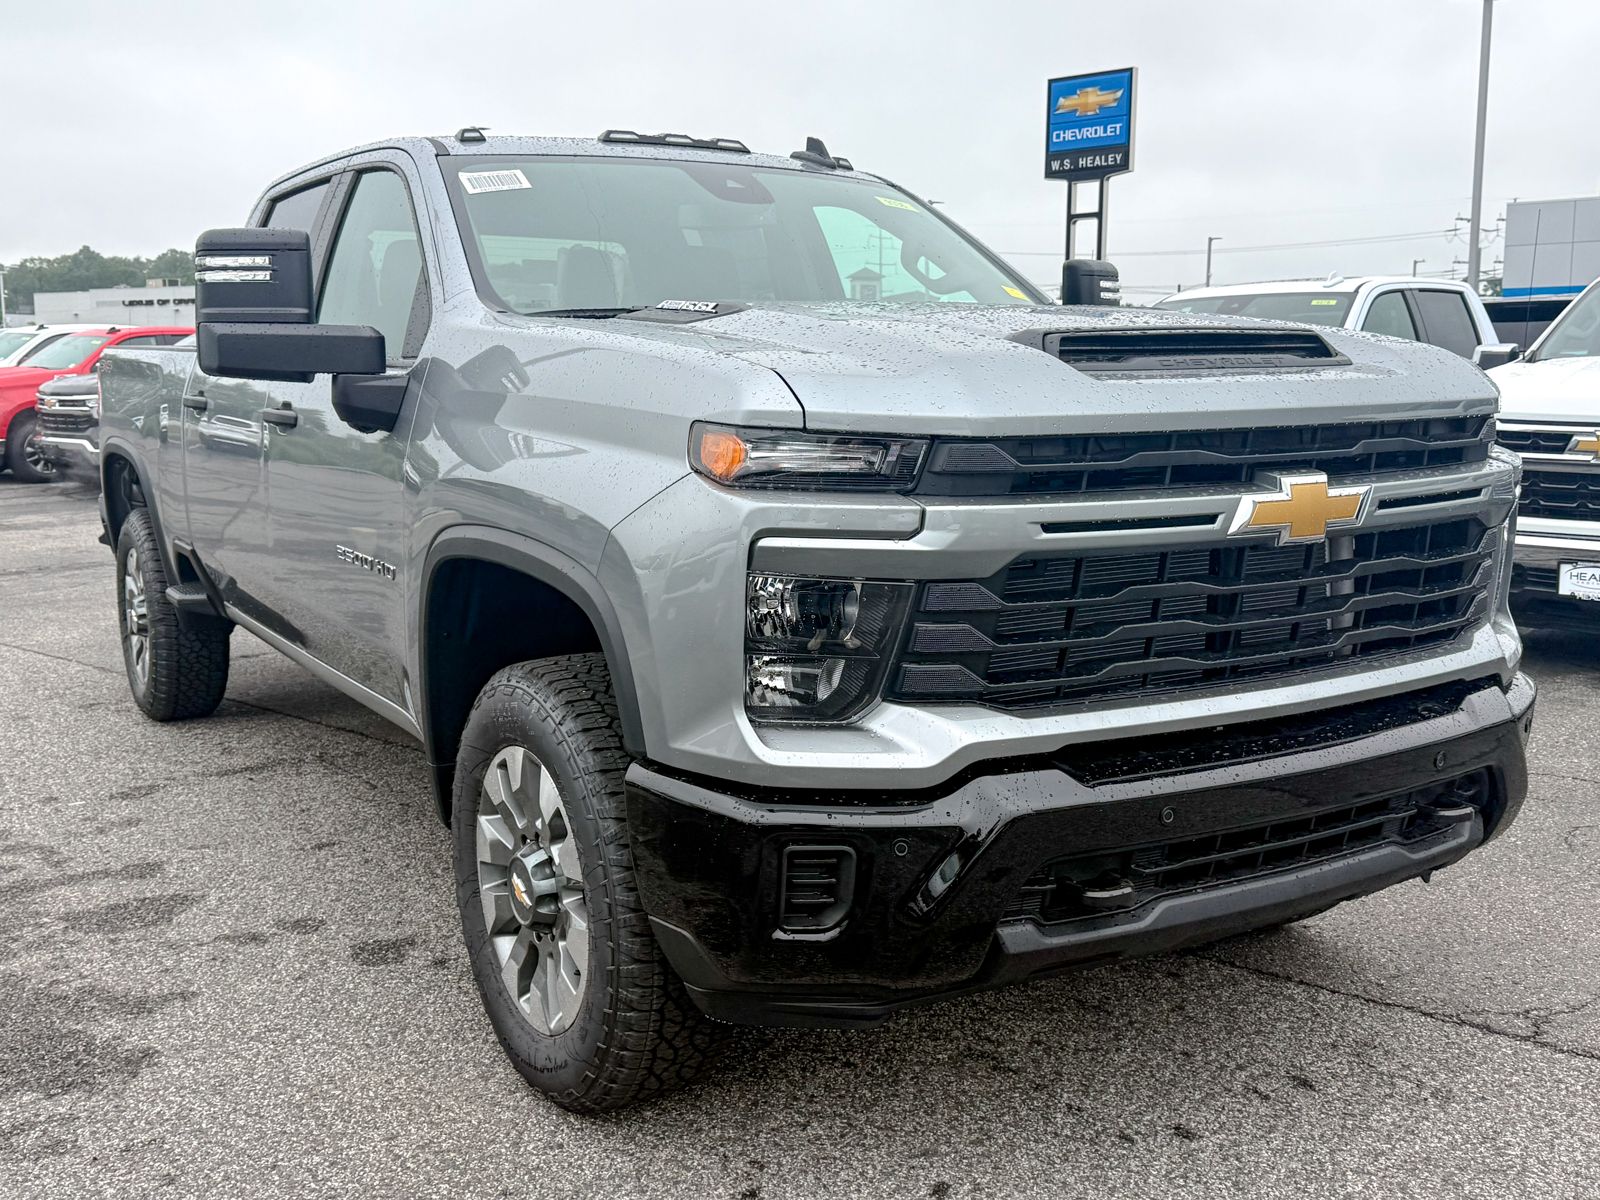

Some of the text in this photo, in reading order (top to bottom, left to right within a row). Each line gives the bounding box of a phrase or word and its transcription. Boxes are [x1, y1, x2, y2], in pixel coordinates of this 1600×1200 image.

[1052, 123, 1123, 142] CHEVROLET
[1051, 153, 1123, 171] W.S. HEALEY
[122, 299, 154, 307] LEXUS
[157, 298, 170, 306] OF
[1157, 356, 1285, 367] CHEVROLET
[1569, 571, 1600, 583] HEA
